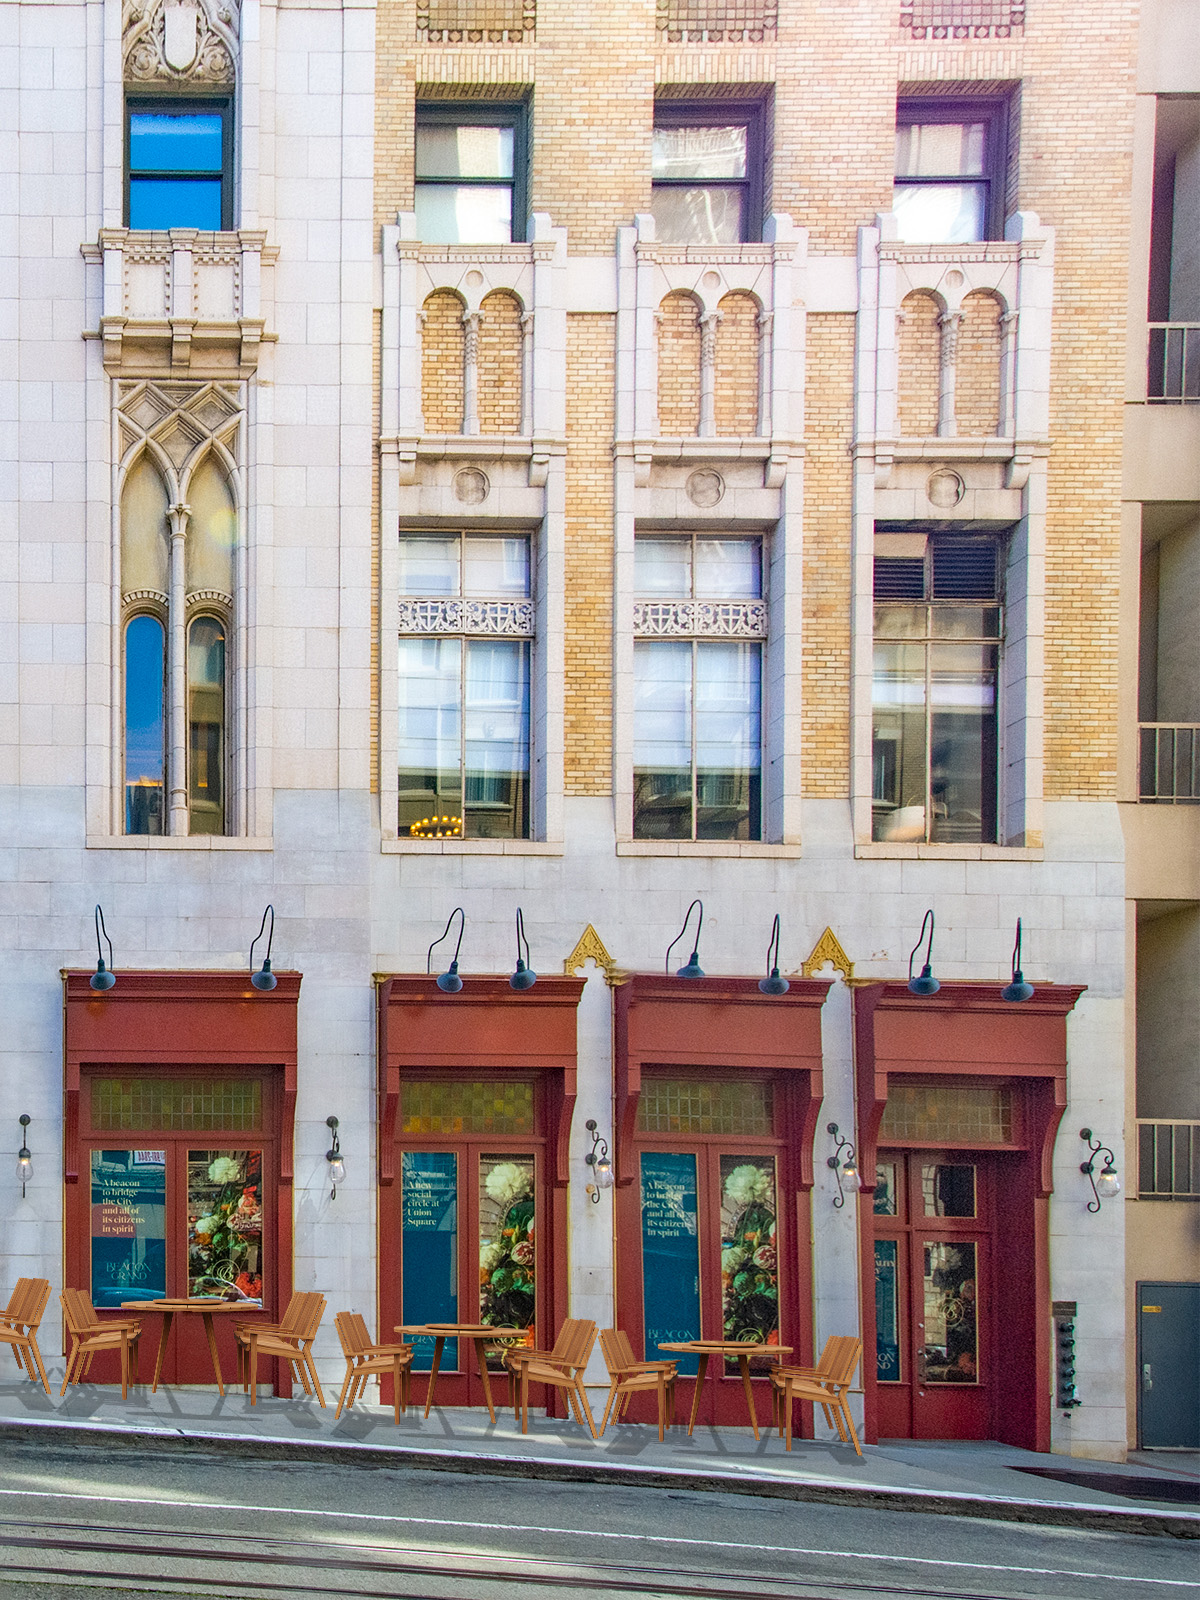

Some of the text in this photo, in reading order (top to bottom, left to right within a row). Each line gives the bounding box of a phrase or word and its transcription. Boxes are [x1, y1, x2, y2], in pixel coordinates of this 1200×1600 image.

[103, 1179, 140, 1187] A beacon
[407, 1181, 414, 1189] A
[654, 1181, 685, 1190] beacon
[111, 1188, 139, 1198] bridge
[407, 1190, 432, 1198] social
[646, 1191, 655, 1199] to
[116, 1198, 133, 1206] City
[407, 1199, 430, 1207] circle
[646, 1200, 660, 1208] the
[102, 1206, 141, 1214] and all of
[407, 1208, 432, 1216] Union
[664, 1210, 675, 1218] all
[102, 1215, 146, 1224] its citizens
[407, 1218, 437, 1227] Square
[647, 1219, 658, 1227] its
[102, 1224, 134, 1235] in spirit
[647, 1228, 680, 1238] in spirit
[106, 1262, 151, 1272] BEACON
[111, 1271, 147, 1280] GRAND
[648, 1328, 695, 1339] BEACON
